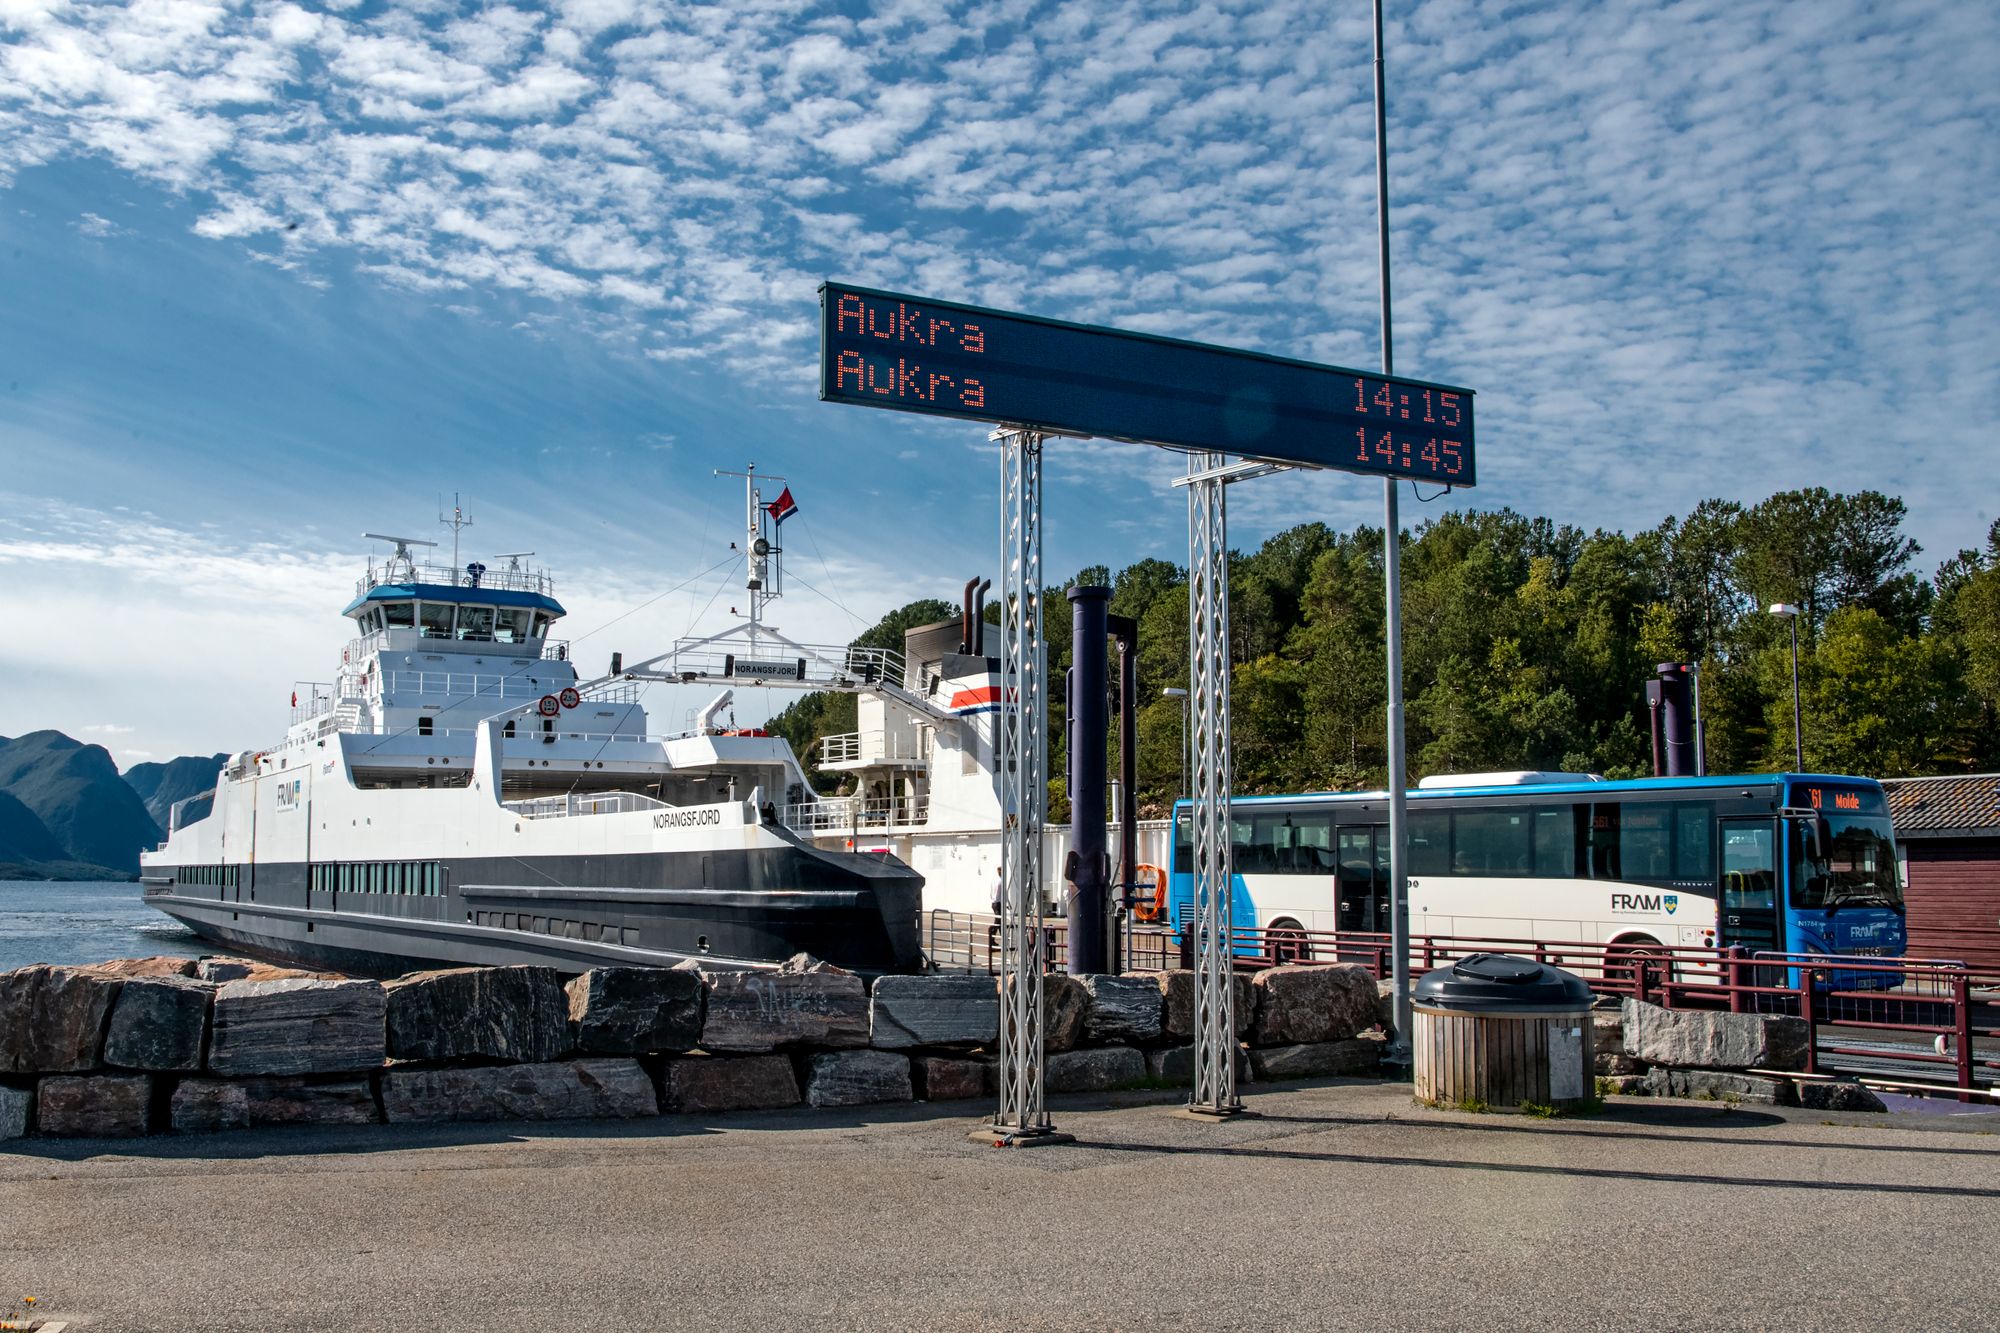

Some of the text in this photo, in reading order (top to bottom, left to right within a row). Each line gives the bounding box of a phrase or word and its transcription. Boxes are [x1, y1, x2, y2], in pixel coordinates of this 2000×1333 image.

[838, 294, 1460, 426] Aukra 14:15
[837, 350, 1462, 474] Aukra 14:45
[735, 665, 796, 675] NORANGSFJORD
[1808, 788, 1859, 809] 61 Molde
[653, 809, 720, 829] NORANGSFJORD
[1611, 894, 1661, 911] FRAM
[1850, 926, 1873, 938] FRAM
